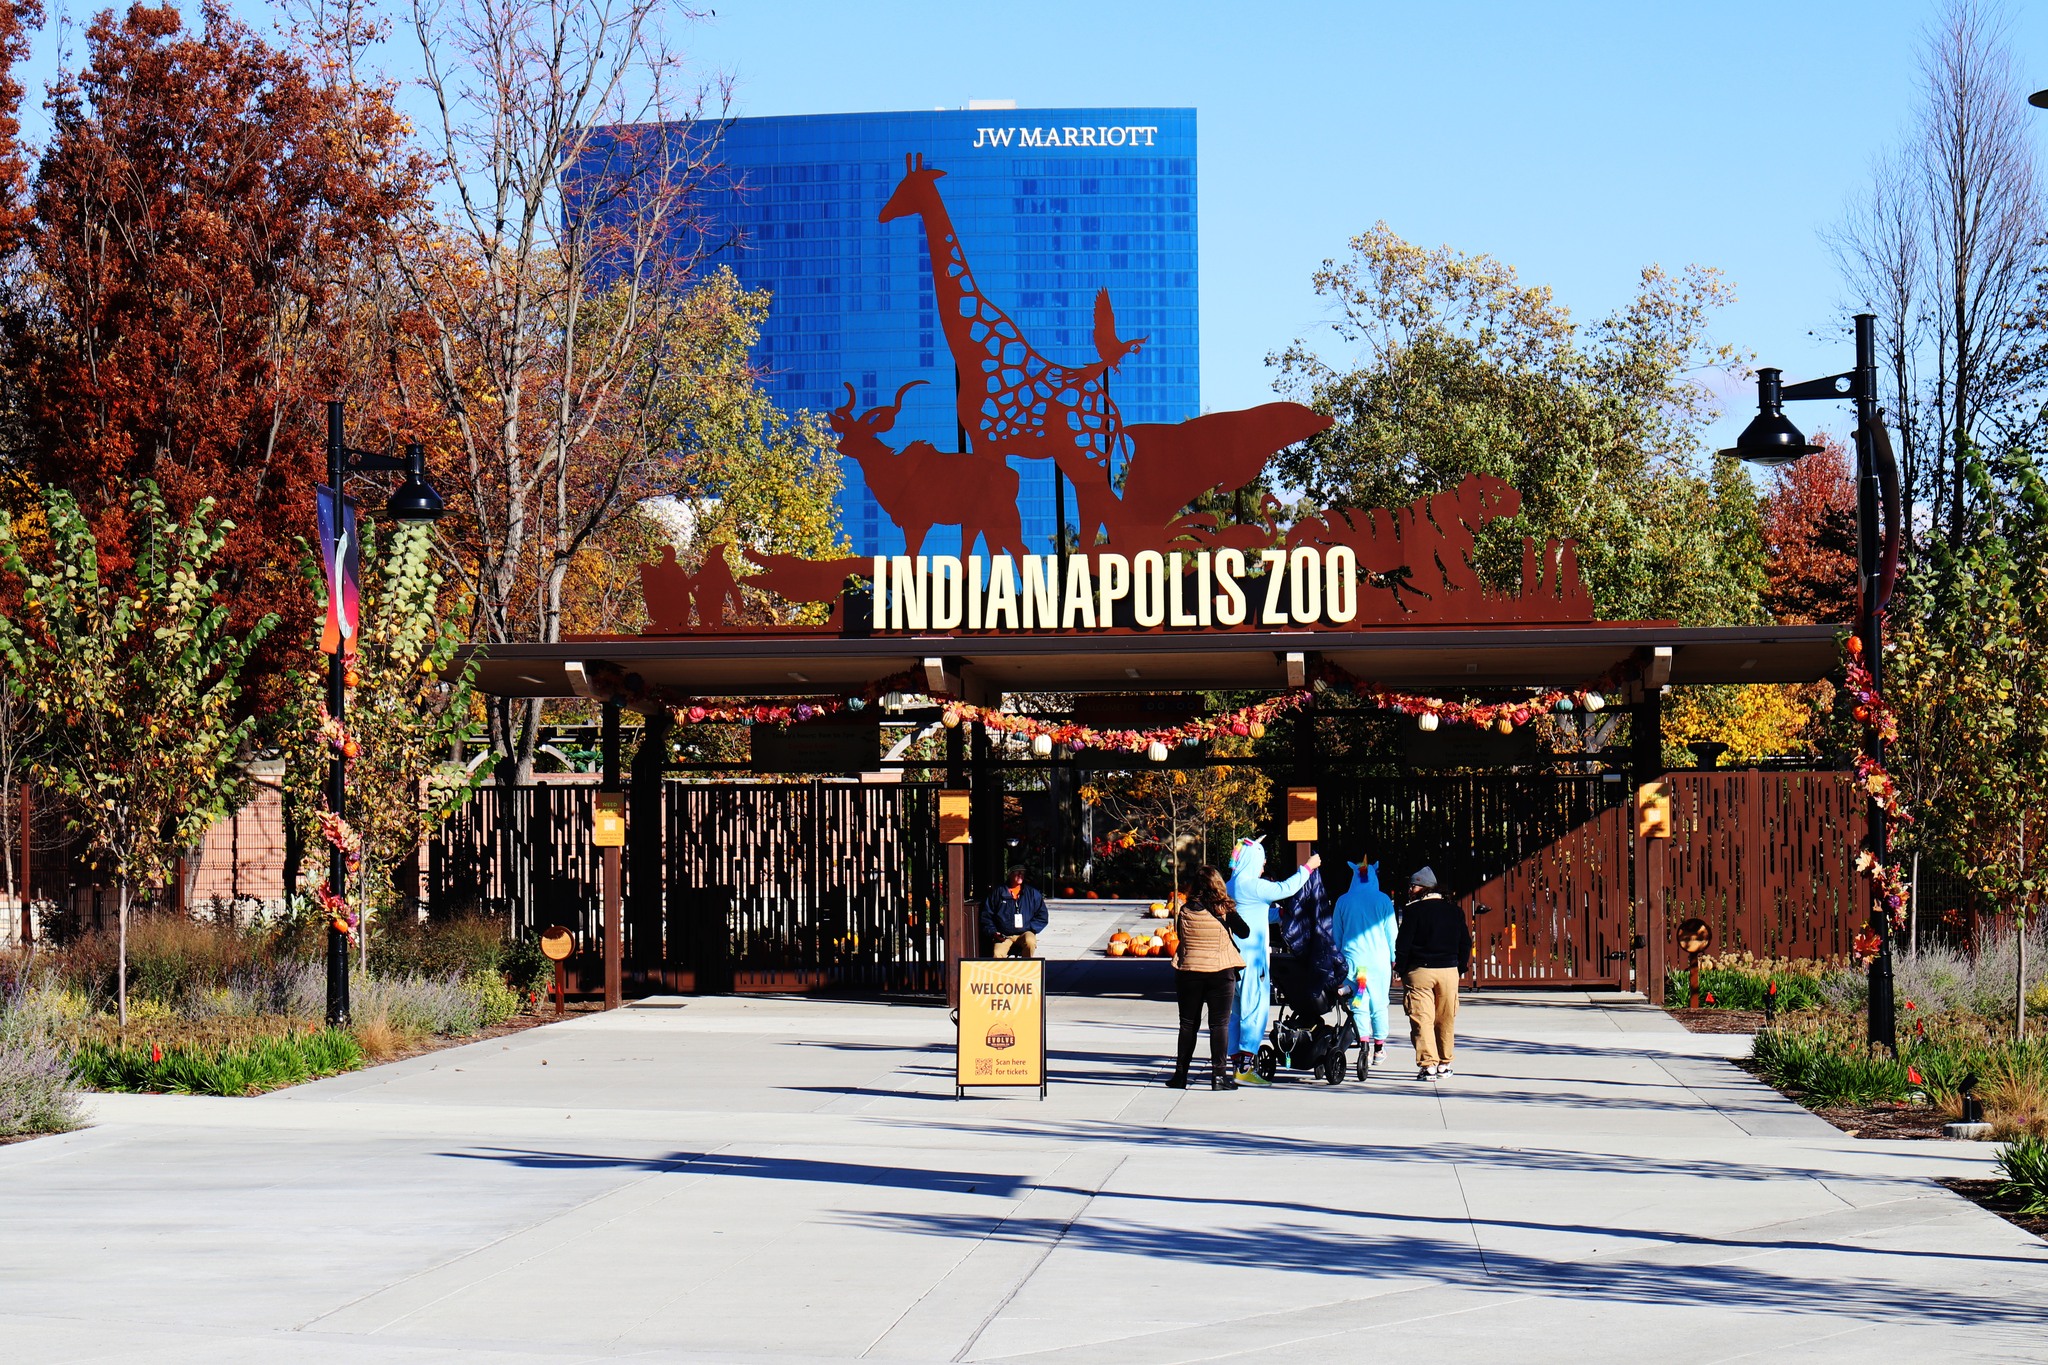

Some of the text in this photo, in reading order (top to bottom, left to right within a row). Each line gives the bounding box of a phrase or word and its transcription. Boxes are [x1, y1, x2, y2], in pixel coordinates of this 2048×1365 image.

[973, 126, 1158, 148] JW MARRIOTT
[872, 546, 1358, 630] INDIANAPOLIS ZOO
[970, 983, 1033, 995] WELCOME
[991, 999, 1012, 1011] FFA
[987, 1036, 1014, 1044] EVOLVE
